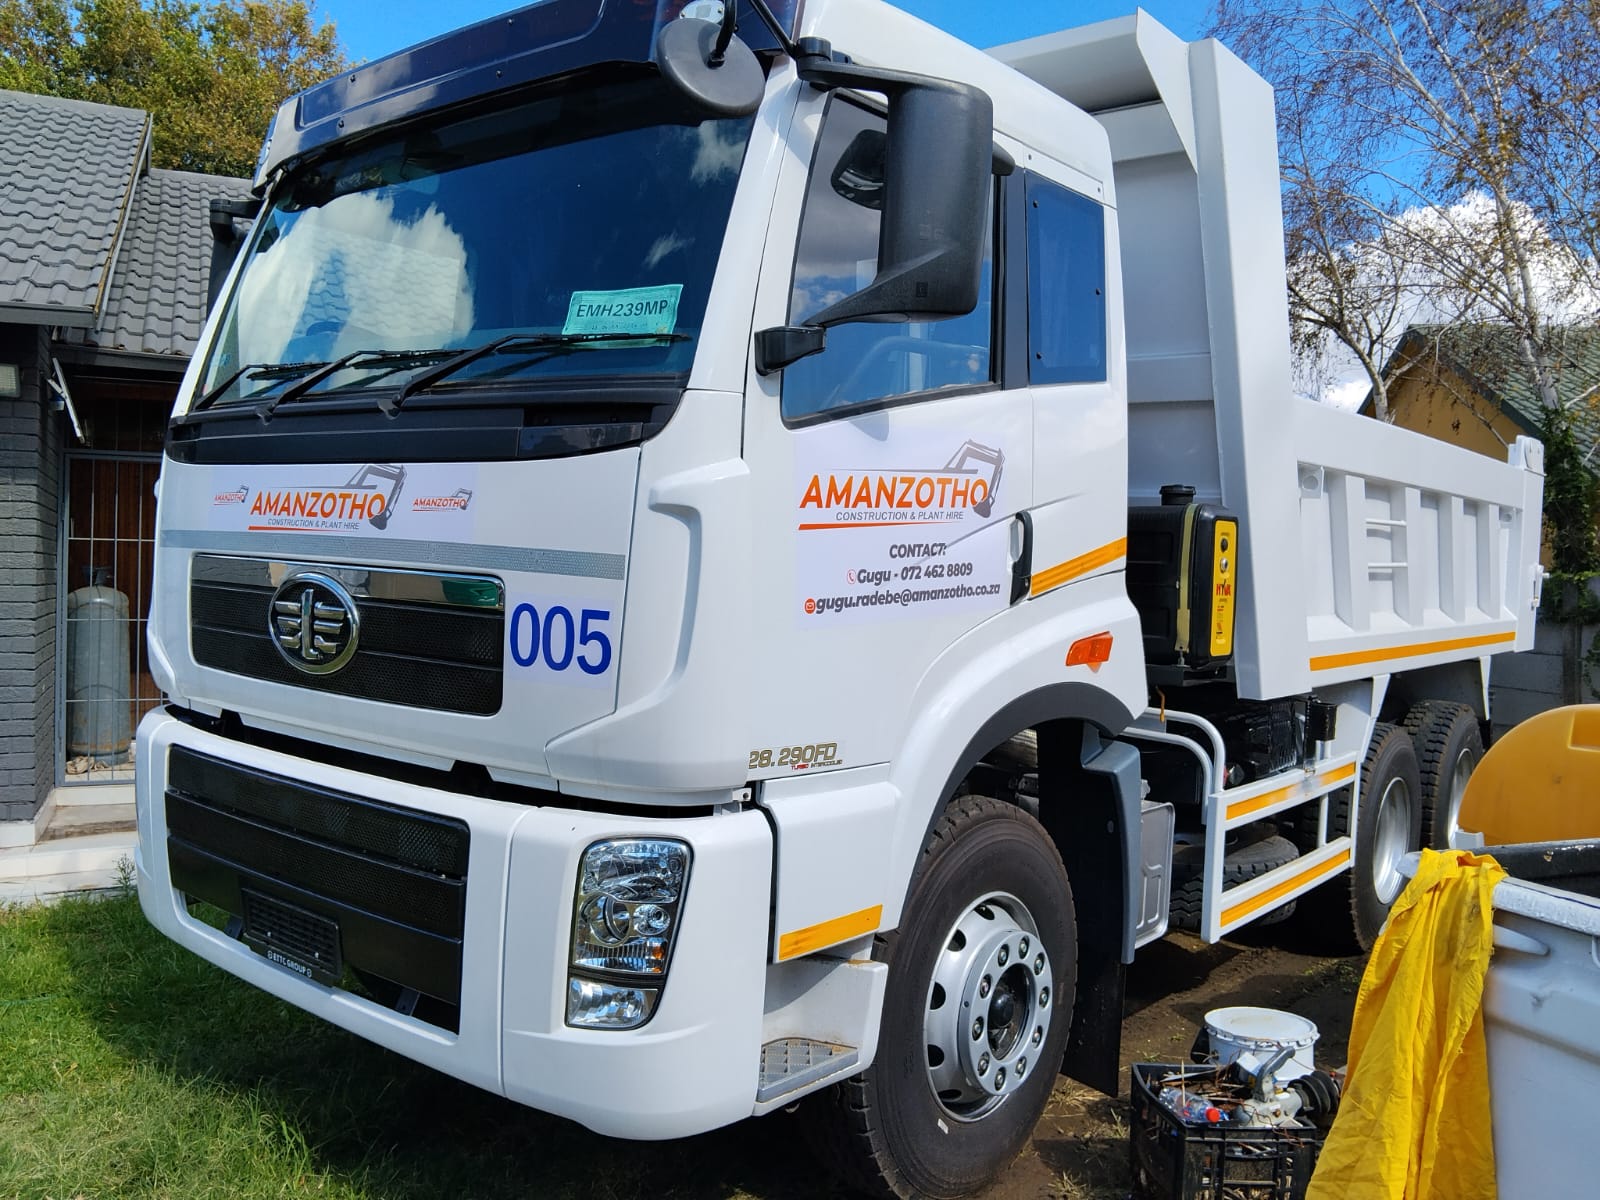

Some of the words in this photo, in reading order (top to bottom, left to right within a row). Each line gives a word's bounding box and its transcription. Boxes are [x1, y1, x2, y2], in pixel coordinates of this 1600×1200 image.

[576, 299, 668, 318] EMH239MP
[799, 474, 989, 509] AMANZOTHO
[250, 490, 387, 521] AMANZOTHO
[413, 497, 467, 508] AMANZOTHO
[267, 518, 314, 528] CONSTRUCTION
[315, 520, 320, 528] &
[321, 521, 343, 530] PLANT
[343, 522, 361, 530] HIRE
[835, 511, 908, 522] CONSTRUCTION
[909, 512, 917, 520] &
[918, 511, 945, 520] PLANT
[945, 511, 964, 520] HIRE
[889, 542, 947, 559] CONTACT:
[857, 568, 892, 586] Gugu
[900, 566, 922, 581] 072
[924, 564, 945, 579] 462
[946, 562, 973, 577] 8809
[816, 583, 1000, 614] gugu.radebe@amanzotho.co.za
[509, 602, 612, 675] 005
